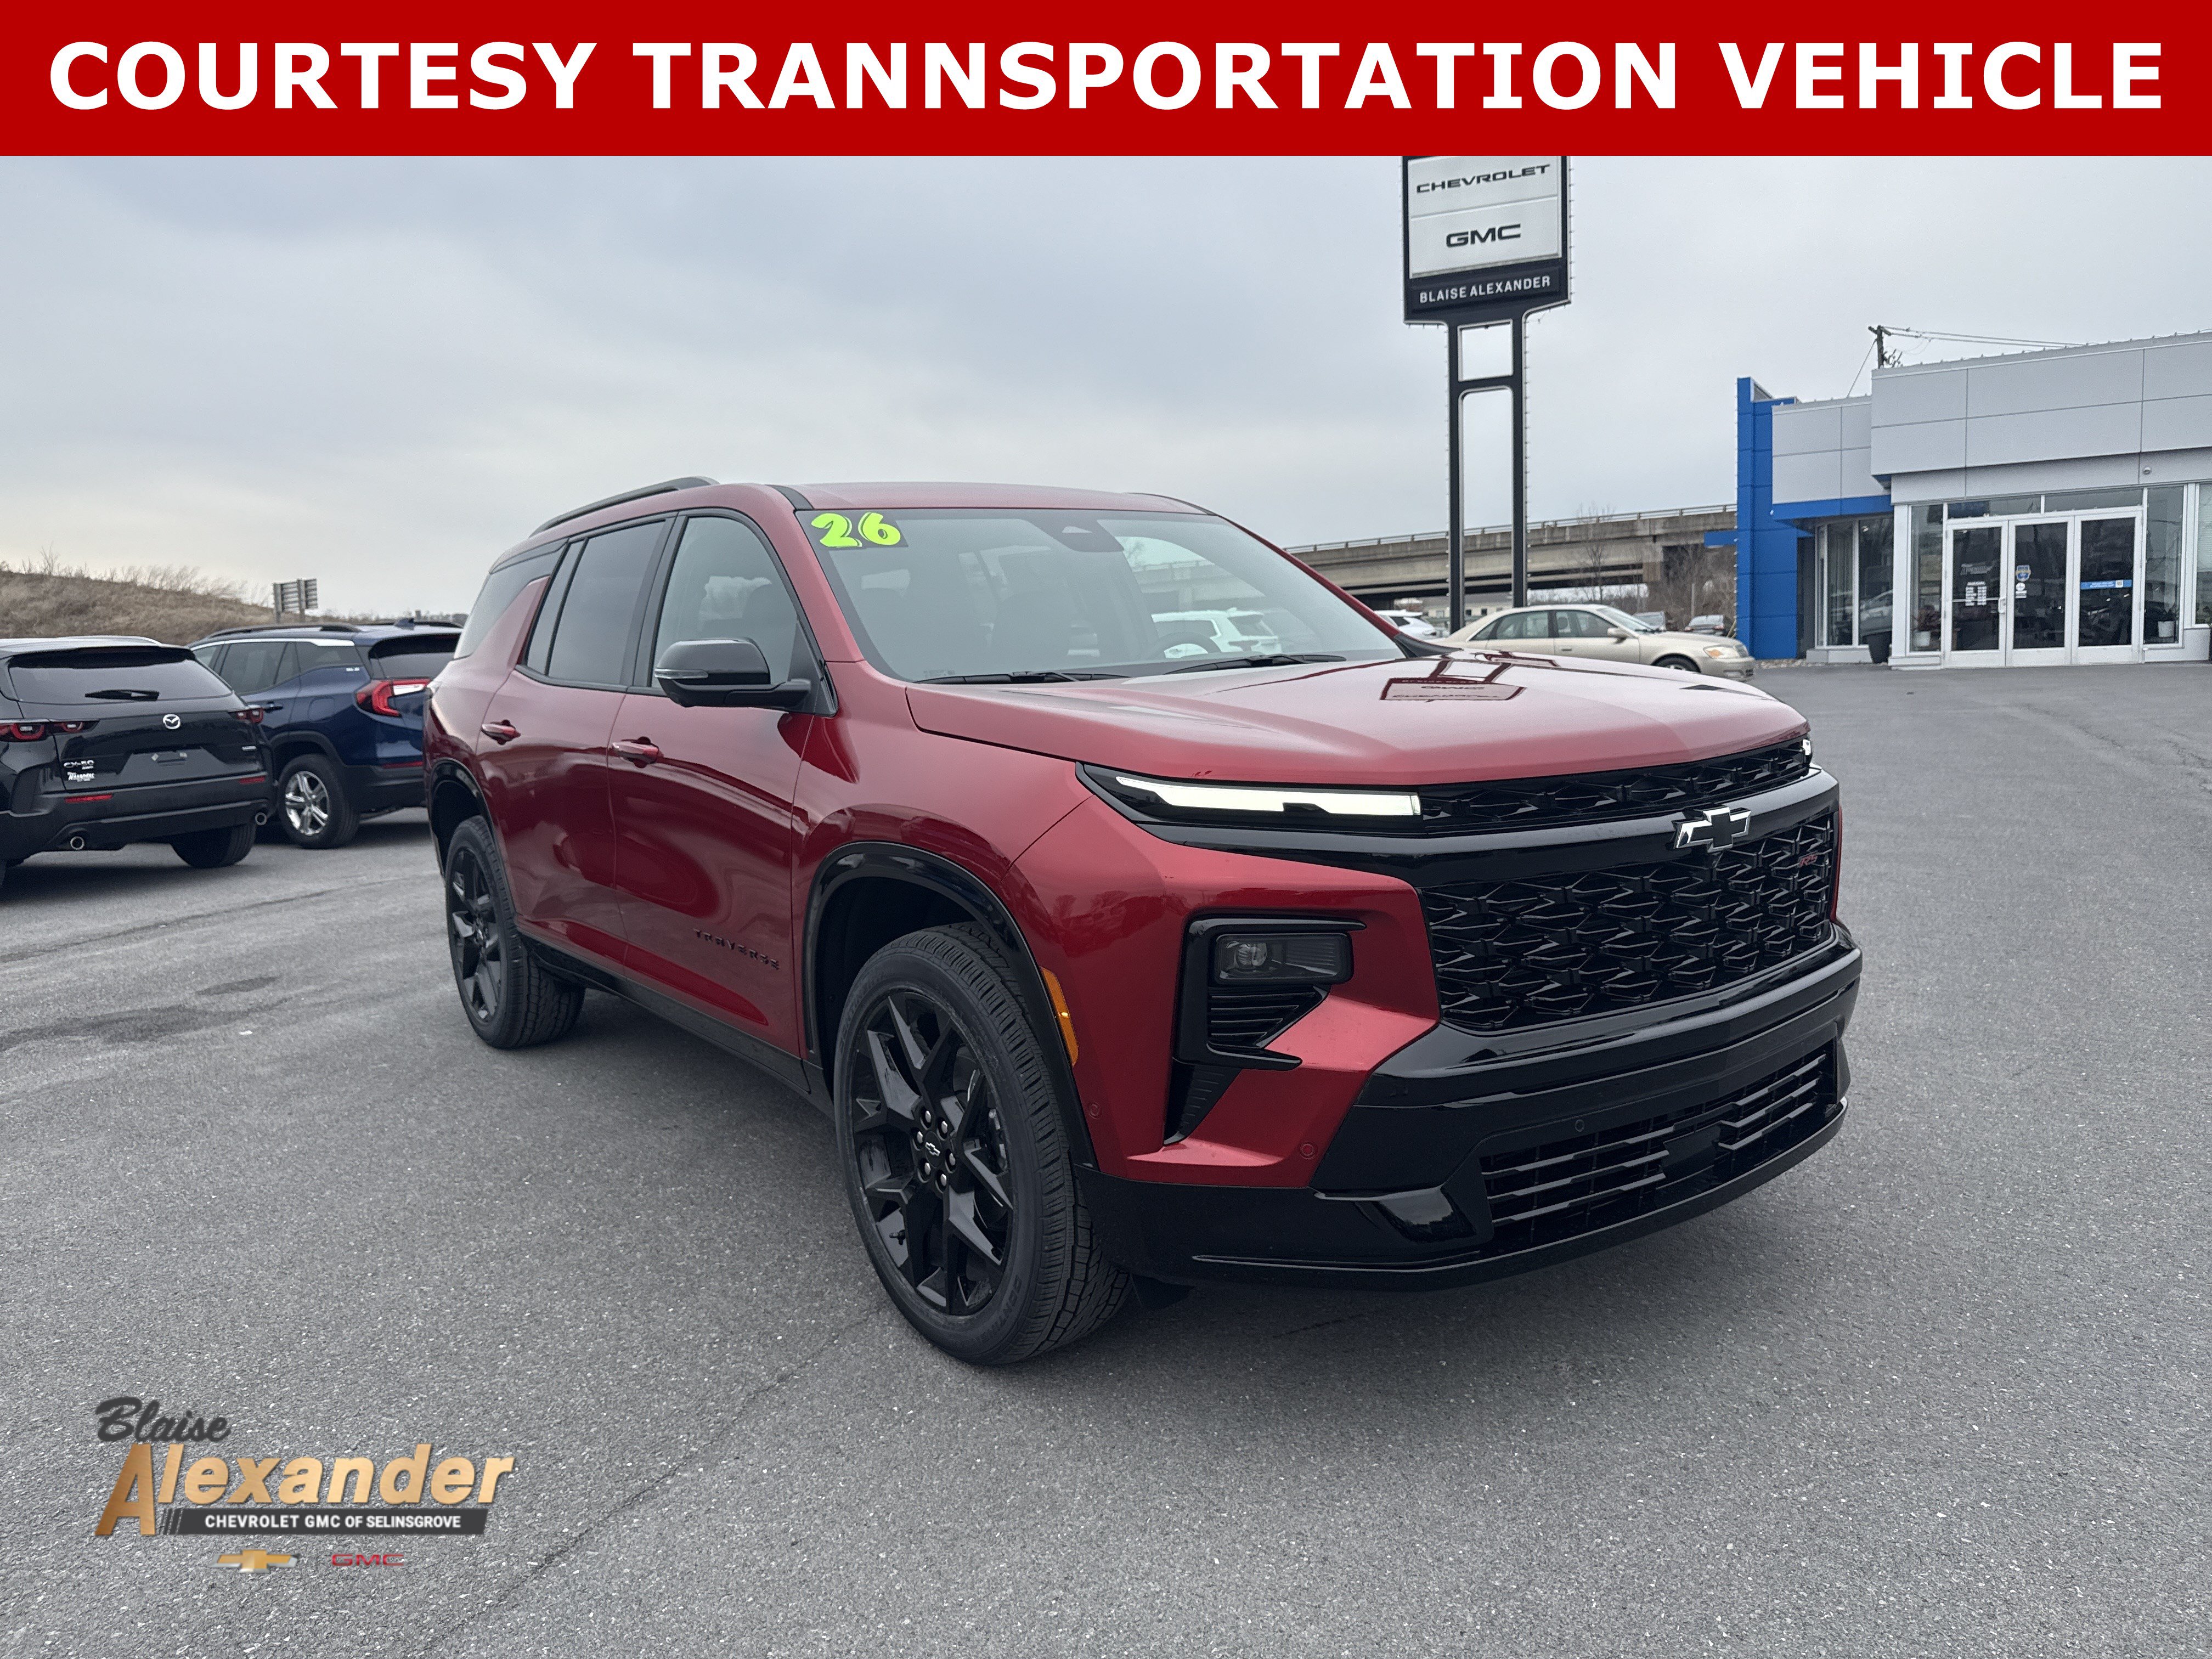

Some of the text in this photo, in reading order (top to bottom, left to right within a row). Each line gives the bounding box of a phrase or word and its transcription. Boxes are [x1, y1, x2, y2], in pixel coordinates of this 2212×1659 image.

[1416, 164, 1550, 194] CHEVROLET
[1446, 223, 1522, 248] GMC
[1419, 275, 1551, 303] BLAISE ALEXANDER
[811, 511, 901, 548] 26
[692, 928, 780, 970] TRAVERSE
